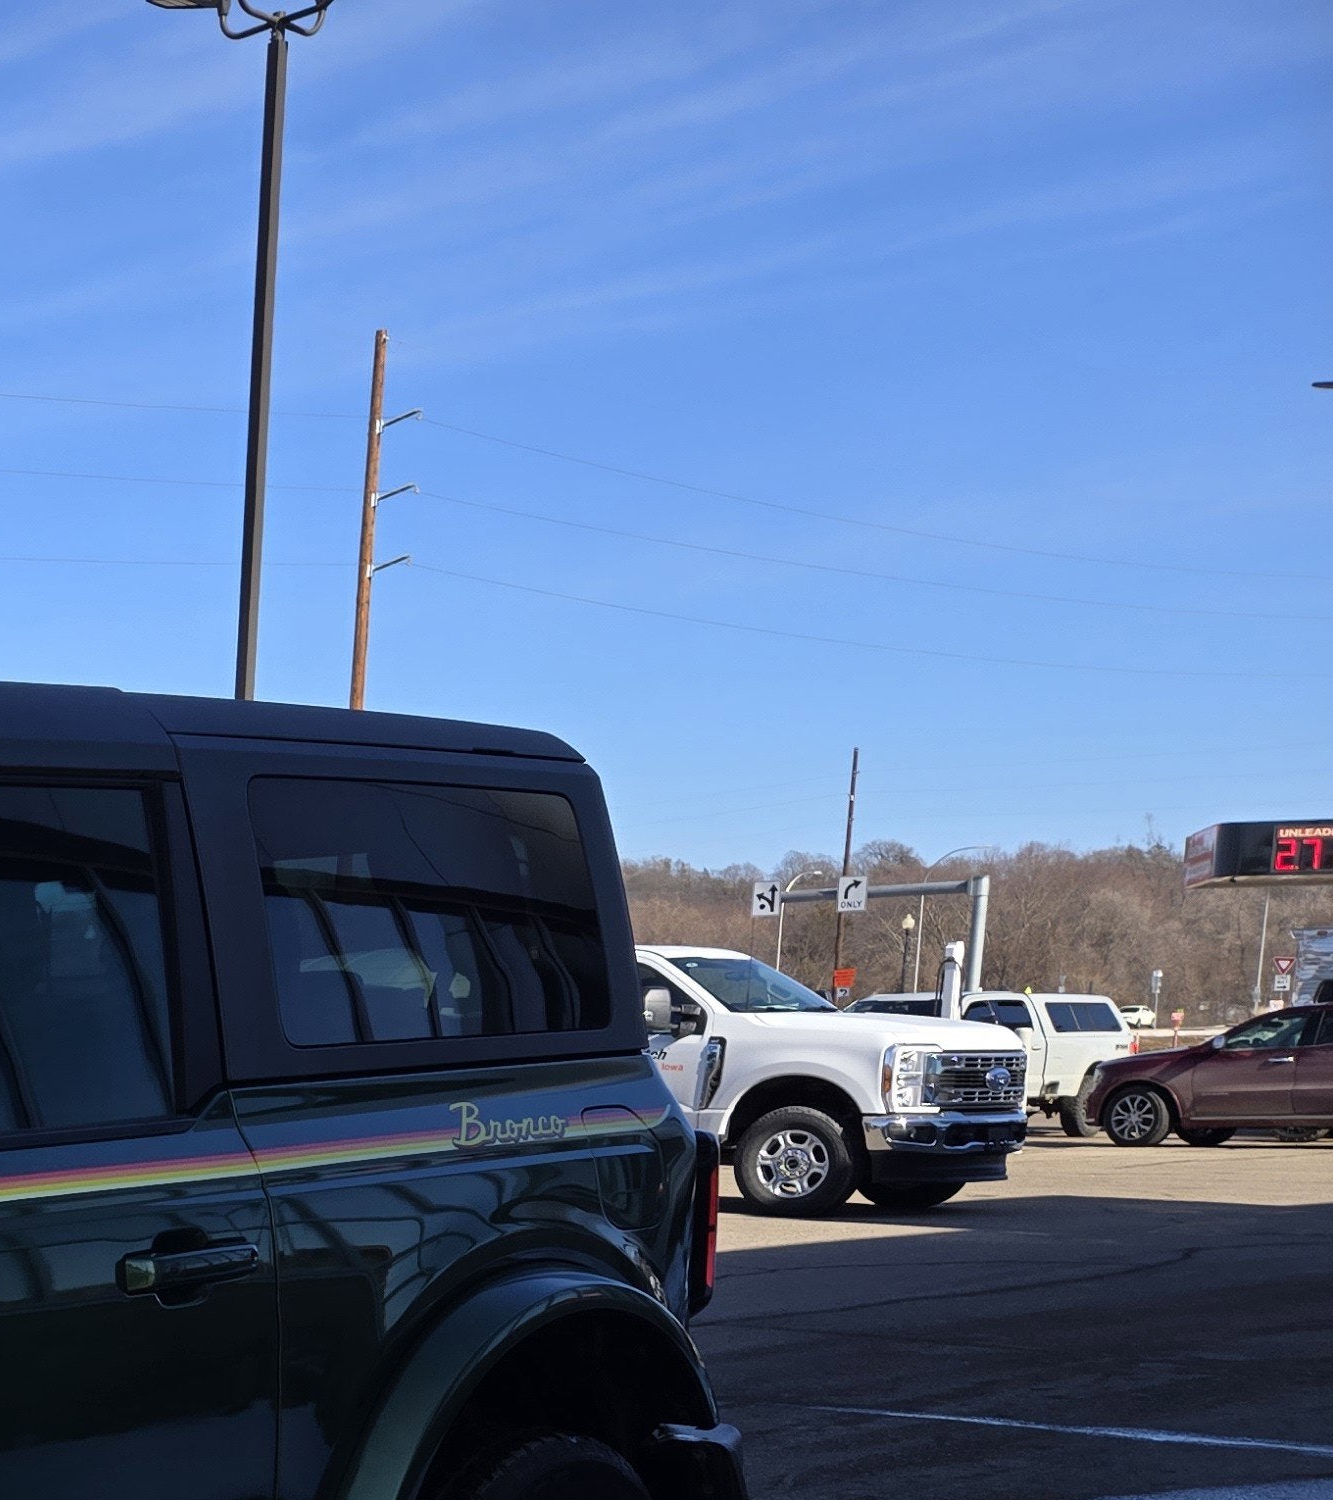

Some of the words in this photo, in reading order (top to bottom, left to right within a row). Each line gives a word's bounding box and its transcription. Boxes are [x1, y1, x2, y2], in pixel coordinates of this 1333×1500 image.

[1279, 827, 1333, 838] UNLEAD
[840, 900, 863, 909] ONLY
[661, 1063, 684, 1071] Iowa
[448, 1101, 566, 1147] Bronco
